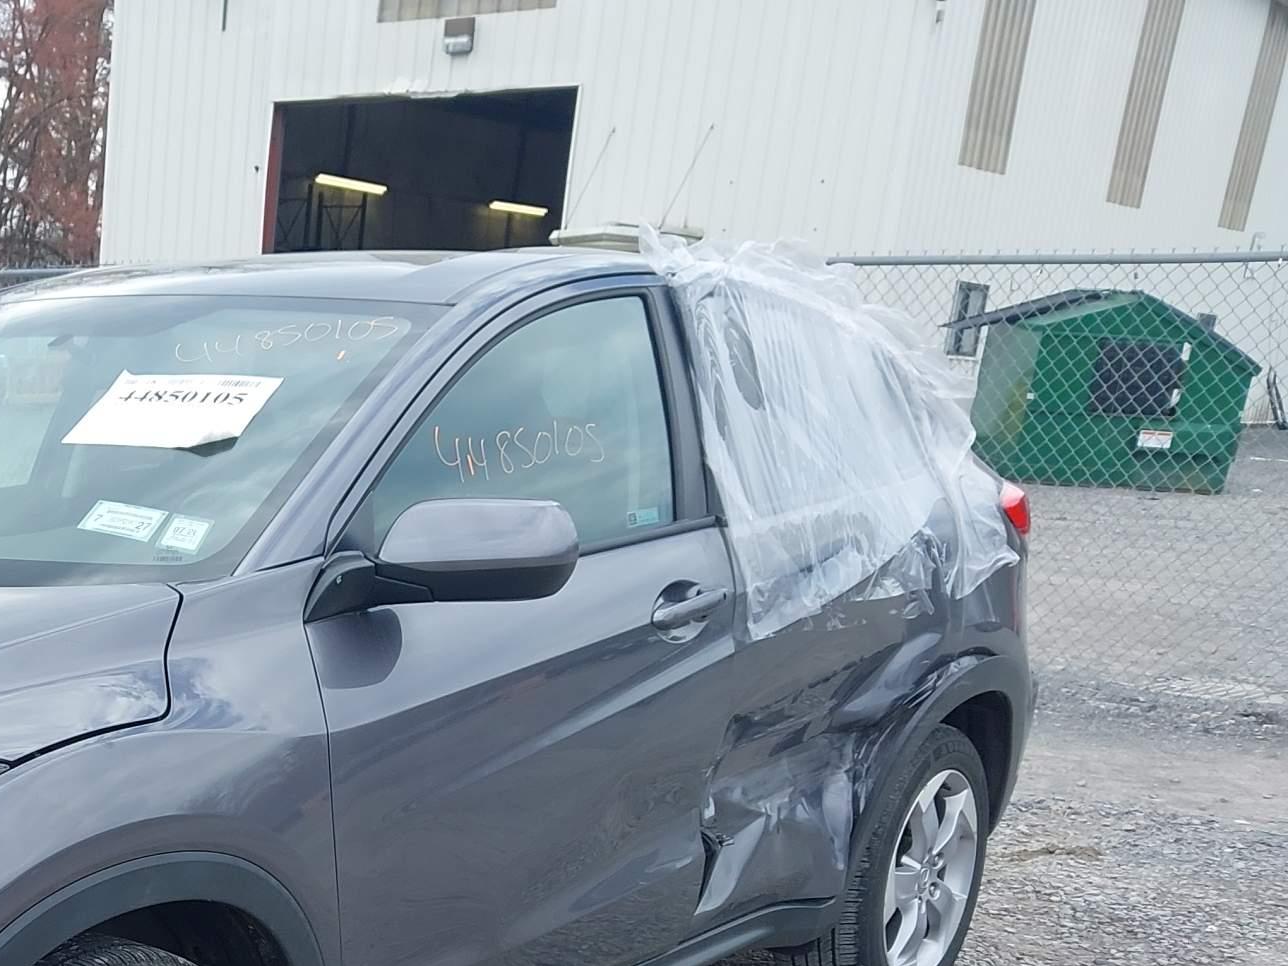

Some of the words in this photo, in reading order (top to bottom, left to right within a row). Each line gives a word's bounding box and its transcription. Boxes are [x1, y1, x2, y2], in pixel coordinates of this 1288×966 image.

[175, 316, 400, 362] 44850105
[118, 389, 249, 406] 44850105
[433, 419, 606, 483] 44850105
